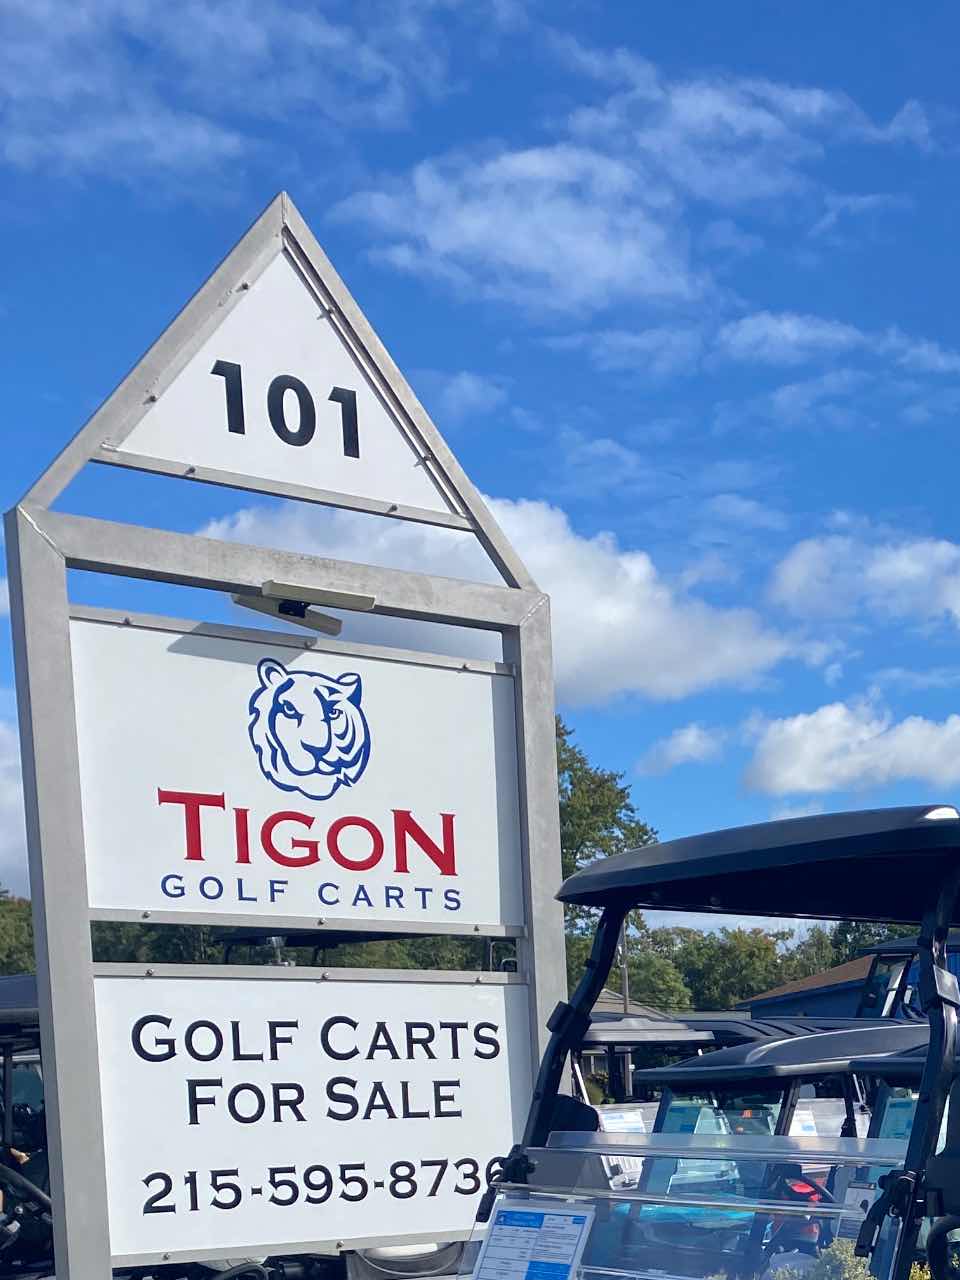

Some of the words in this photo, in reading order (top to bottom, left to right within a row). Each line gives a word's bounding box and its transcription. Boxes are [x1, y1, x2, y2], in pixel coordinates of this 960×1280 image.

[211, 360, 360, 458] 101
[158, 788, 458, 876] TIGON
[161, 873, 289, 903] GOLF
[318, 882, 461, 911] CARTS
[132, 1015, 298, 1062] GOLF
[321, 1016, 500, 1060] CARTS
[186, 1078, 307, 1125] FOR
[326, 1077, 462, 1121] SALE
